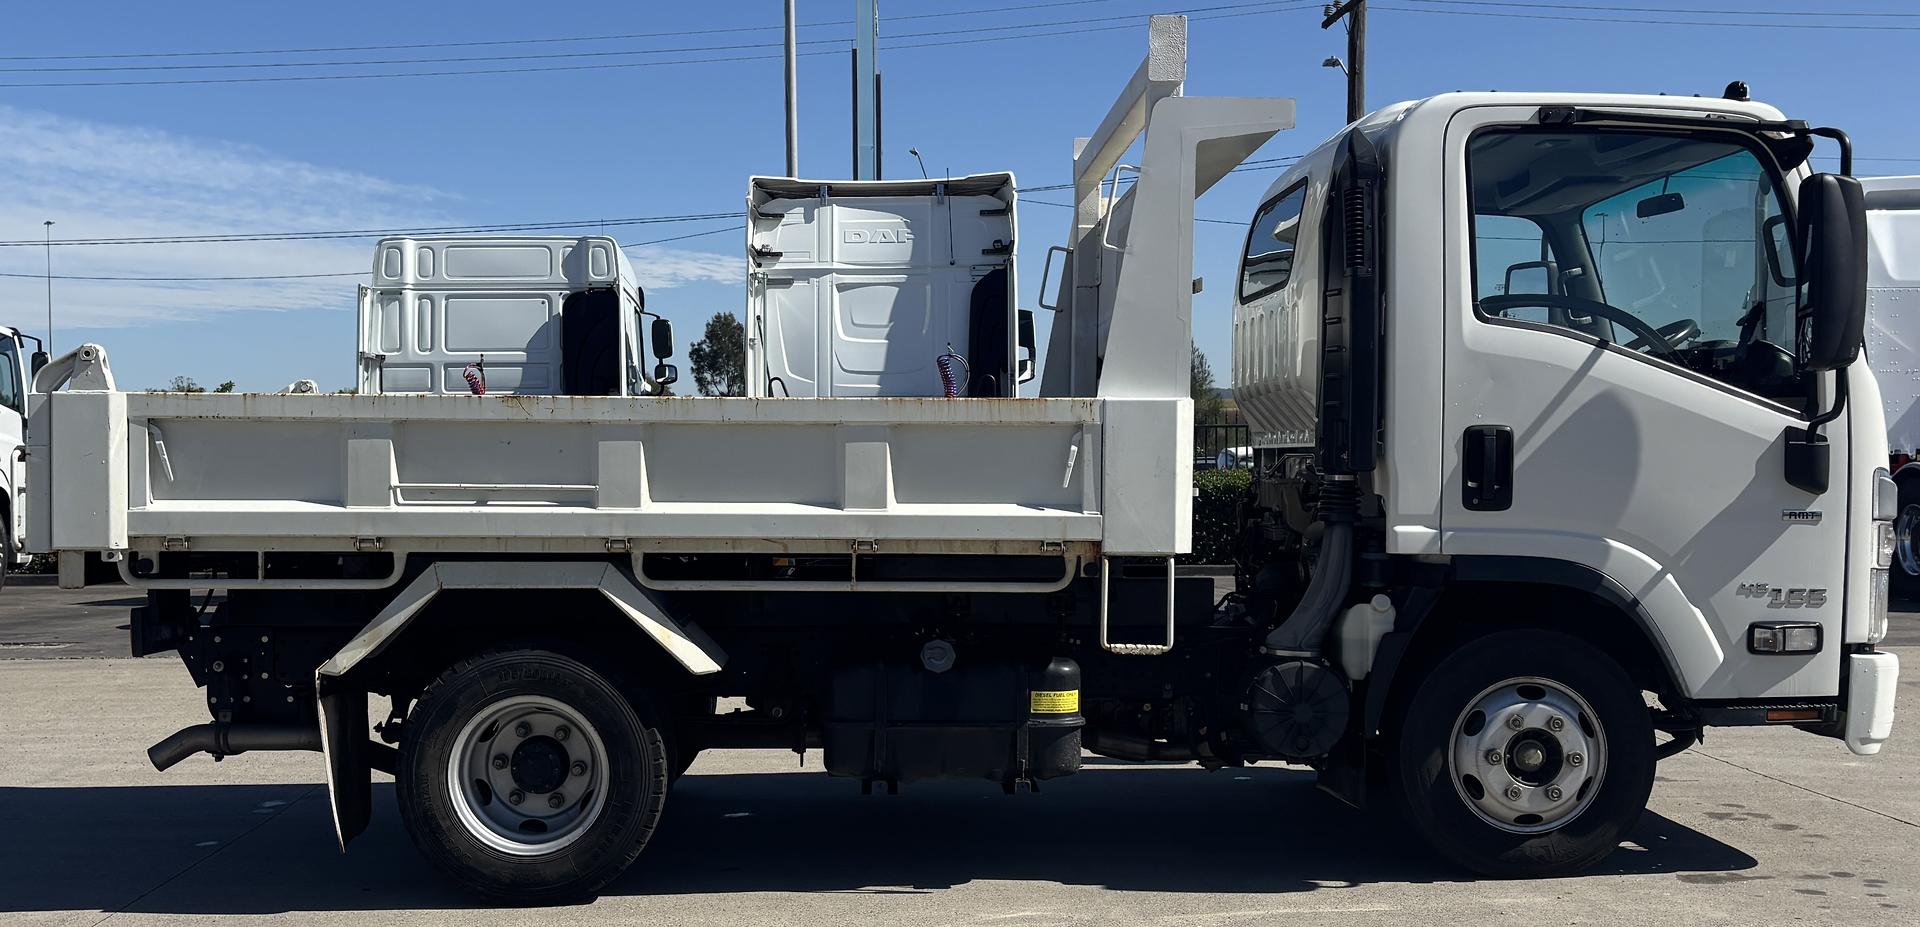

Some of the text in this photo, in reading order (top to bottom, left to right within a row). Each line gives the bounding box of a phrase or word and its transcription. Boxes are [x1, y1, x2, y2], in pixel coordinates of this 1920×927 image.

[844, 229, 915, 244] DAF
[1788, 511, 1816, 520] AMT
[1767, 588, 1827, 609] 155
